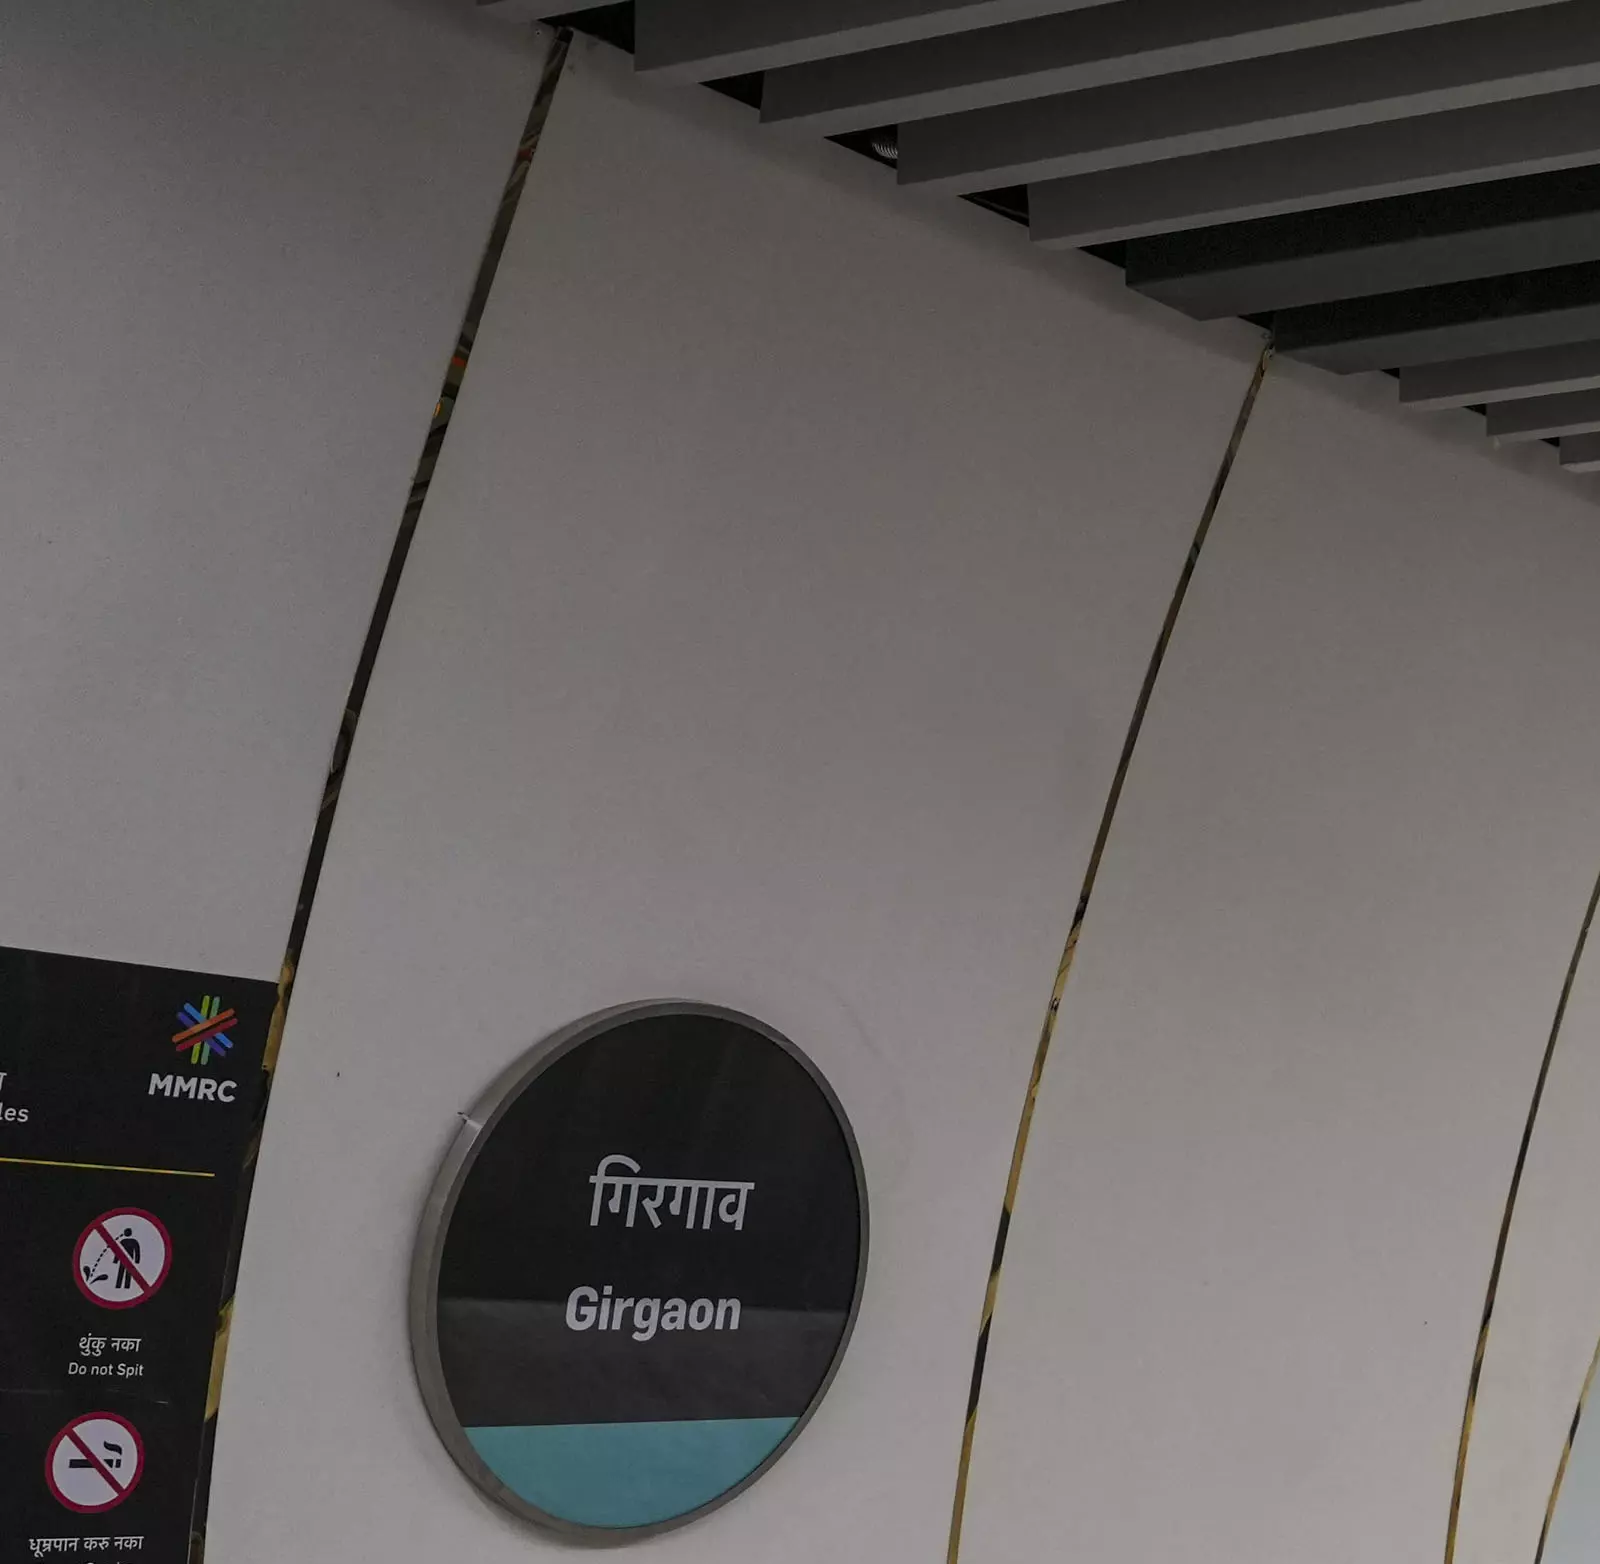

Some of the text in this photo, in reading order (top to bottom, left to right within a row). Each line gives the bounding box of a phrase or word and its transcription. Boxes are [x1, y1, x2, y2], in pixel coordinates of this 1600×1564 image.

[148, 1073, 238, 1102] MMRC
[589, 1154, 755, 1231] गिरगाव
[565, 1285, 741, 1341] Girgaon
[111, 1338, 142, 1352] नका
[68, 1362, 144, 1378] Do not Spit
[29, 1538, 80, 1558] धूम्रपान
[114, 1536, 144, 1550] नका
